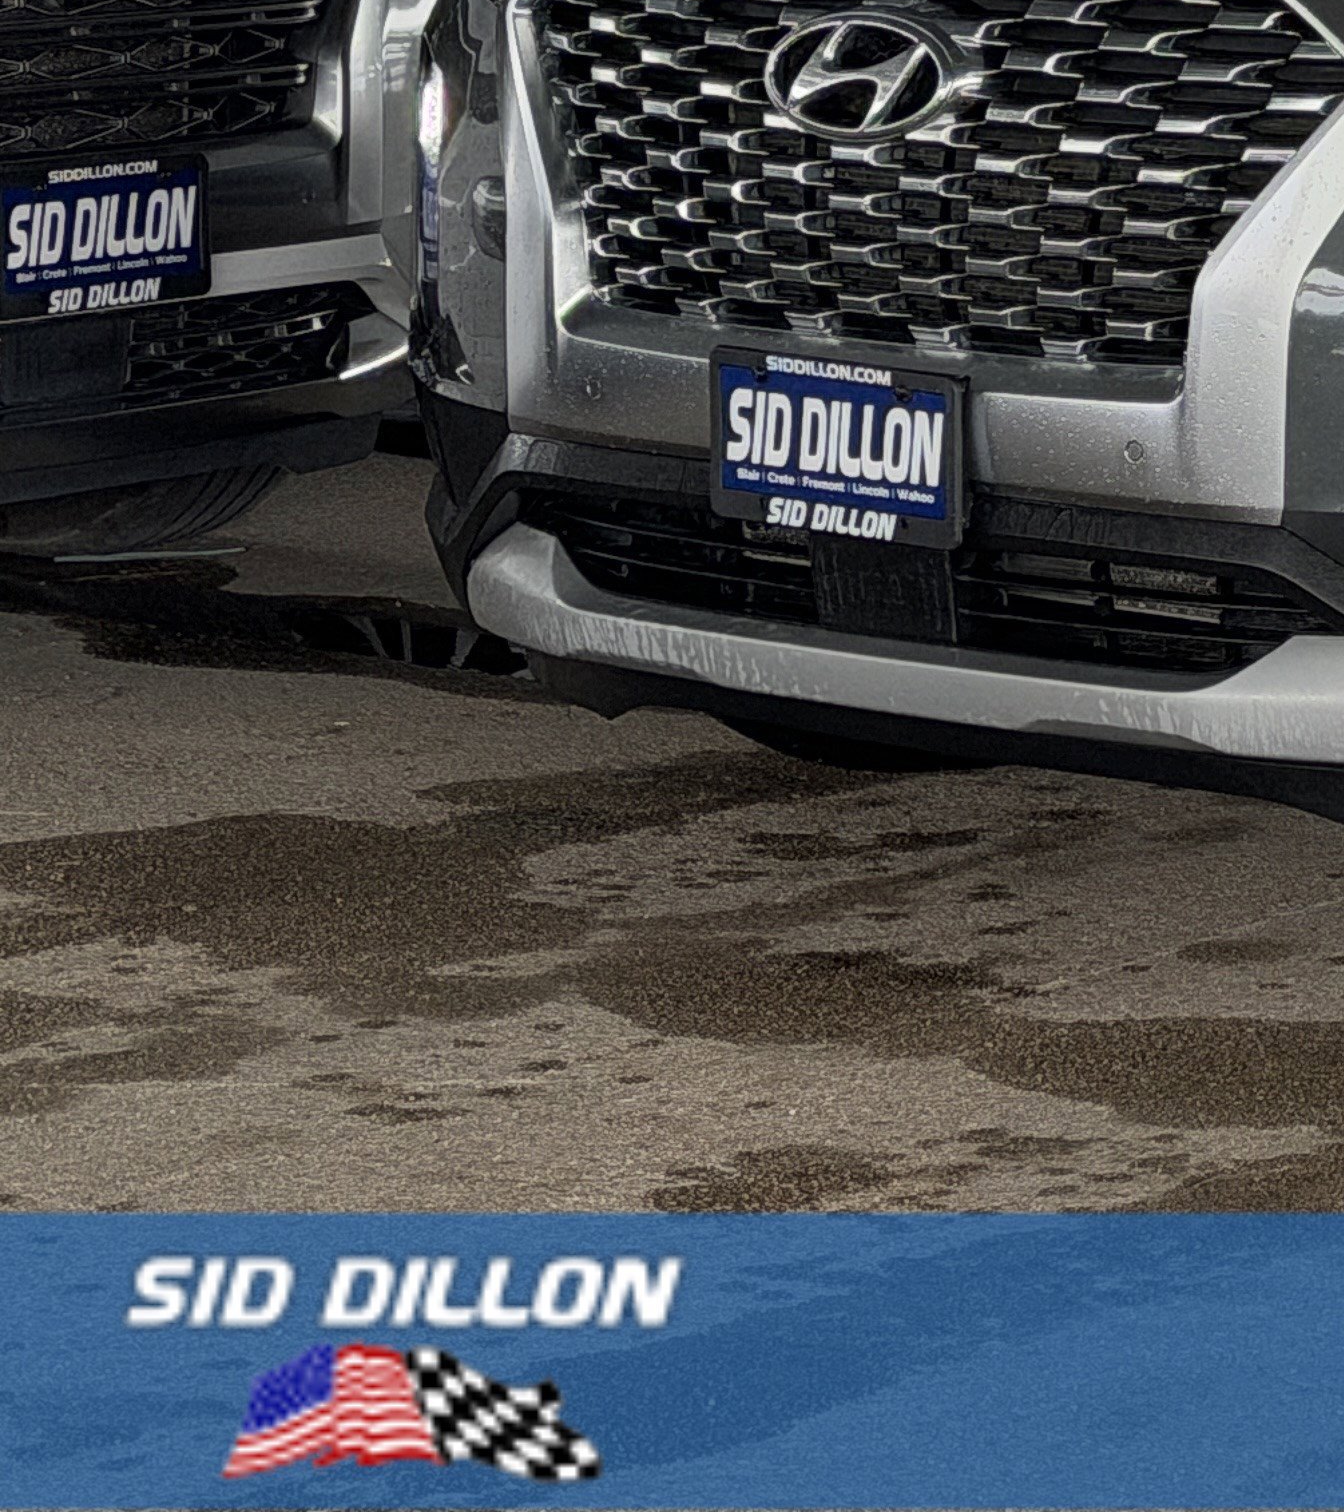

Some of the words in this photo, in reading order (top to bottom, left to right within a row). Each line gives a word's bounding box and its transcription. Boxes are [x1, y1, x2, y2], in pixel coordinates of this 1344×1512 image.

[48, 159, 158, 184] SIDDILLON.COM
[6, 201, 66, 270] SID
[71, 185, 197, 262] DILLON
[73, 262, 111, 276] Fremont
[47, 288, 83, 314] SID
[86, 276, 162, 308] DILLON
[766, 355, 892, 386] SIDDILLON.COM
[726, 388, 792, 467] SID
[799, 397, 944, 487] DILLON
[802, 475, 845, 493] Fremont
[853, 482, 889, 499] Lincoln
[766, 497, 807, 527] SID
[810, 503, 897, 541] DILLON
